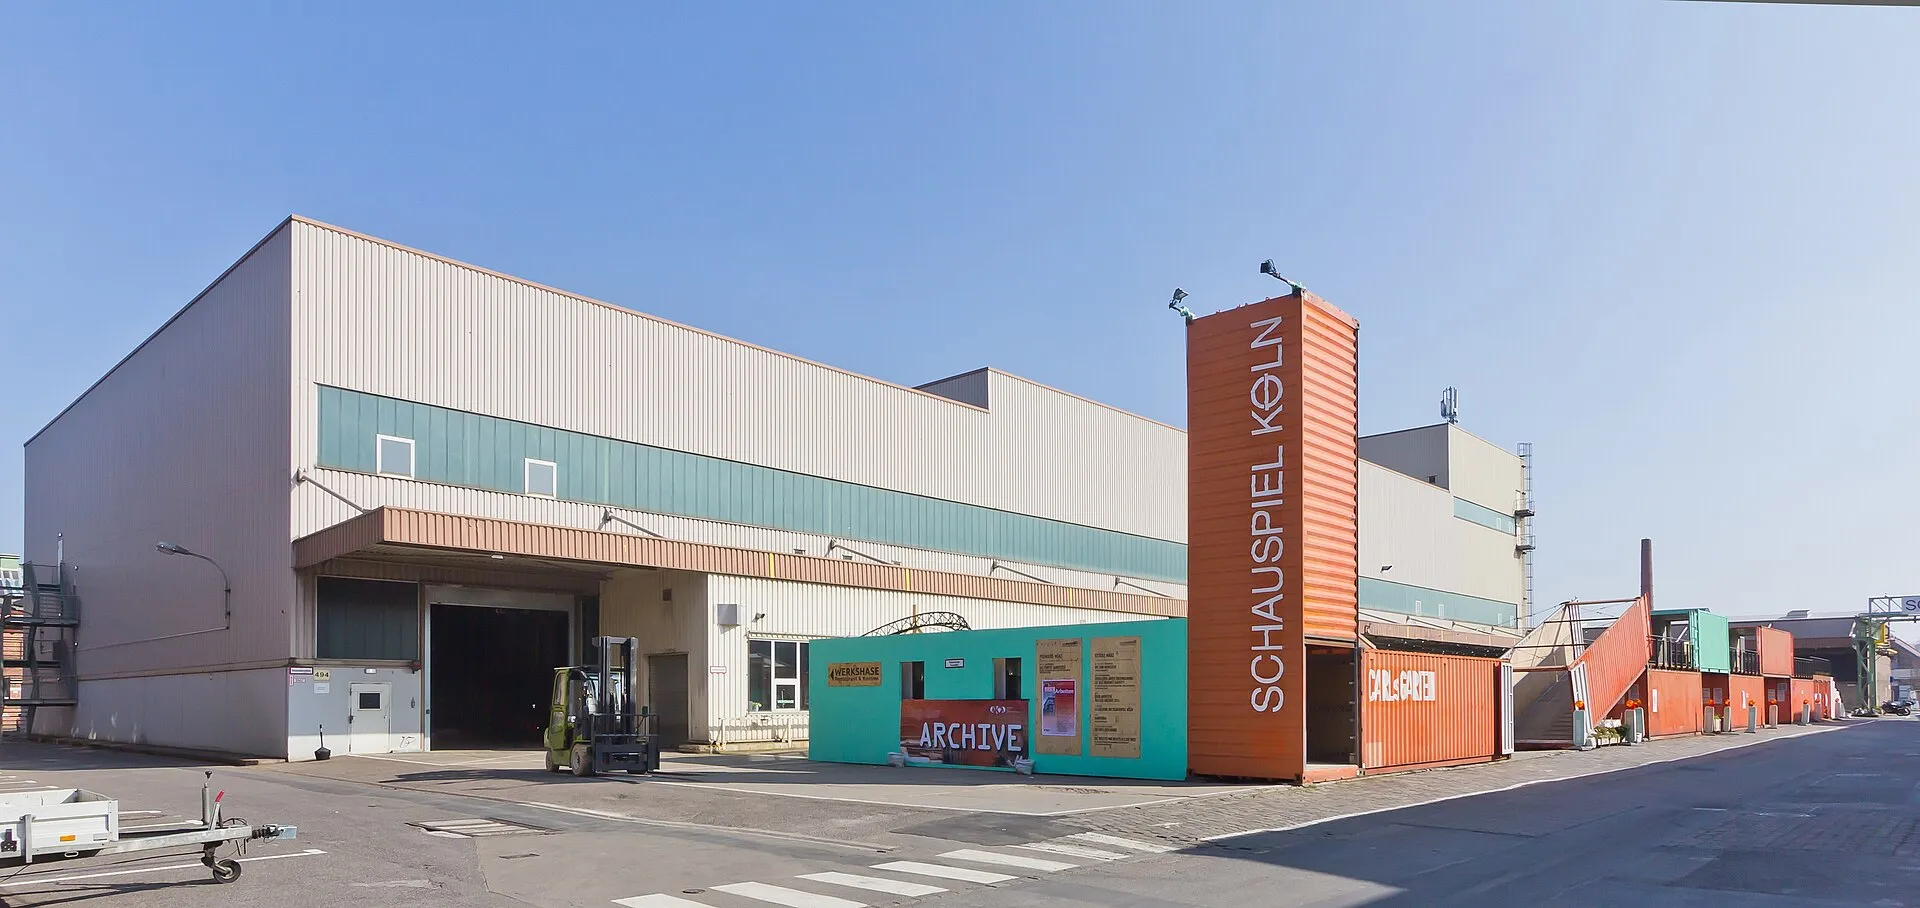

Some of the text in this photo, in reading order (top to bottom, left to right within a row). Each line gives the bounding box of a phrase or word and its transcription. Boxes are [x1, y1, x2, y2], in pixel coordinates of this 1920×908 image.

[1250, 445, 1283, 713] SCHAUSPIEL
[835, 667, 880, 676] WERKSHASE
[919, 722, 1023, 752] ARCHIVE
